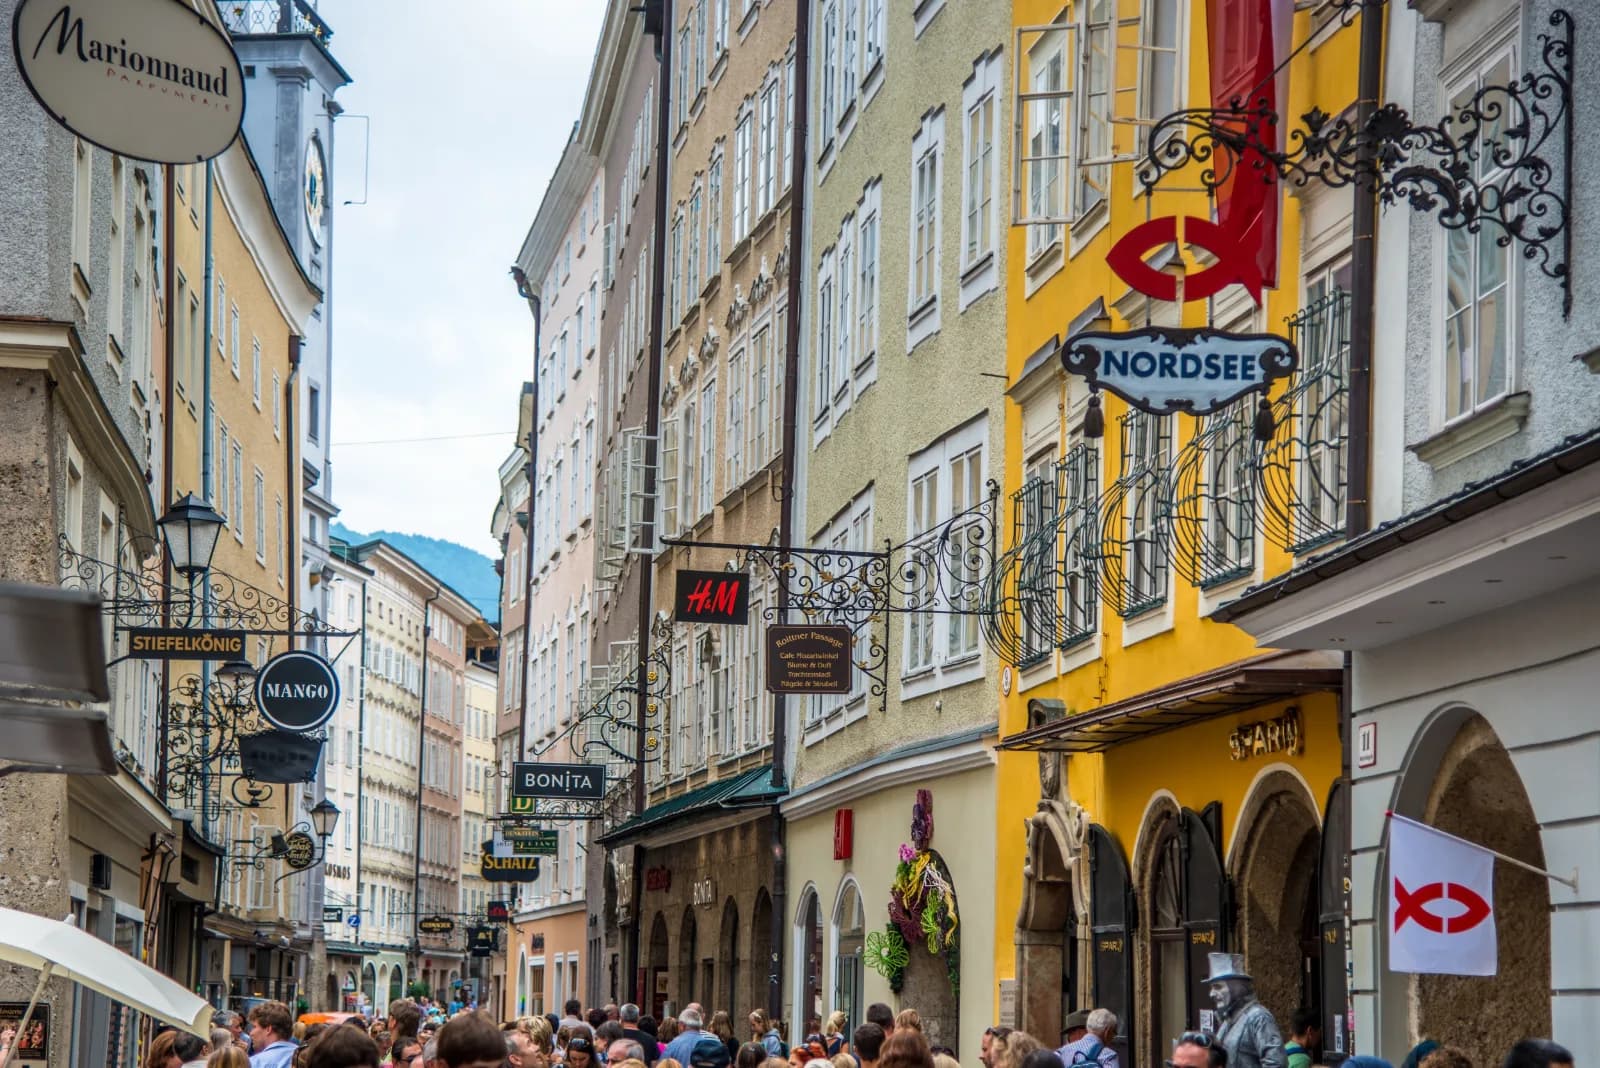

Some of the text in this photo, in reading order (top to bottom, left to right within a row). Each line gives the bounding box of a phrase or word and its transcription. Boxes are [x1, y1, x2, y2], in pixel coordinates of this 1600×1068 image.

[32, 5, 229, 98] Marionnaud
[1103, 350, 1256, 381] NORDSEE
[687, 578, 740, 616] H&M
[810, 631, 843, 649] Passage
[266, 683, 329, 699] MANGO
